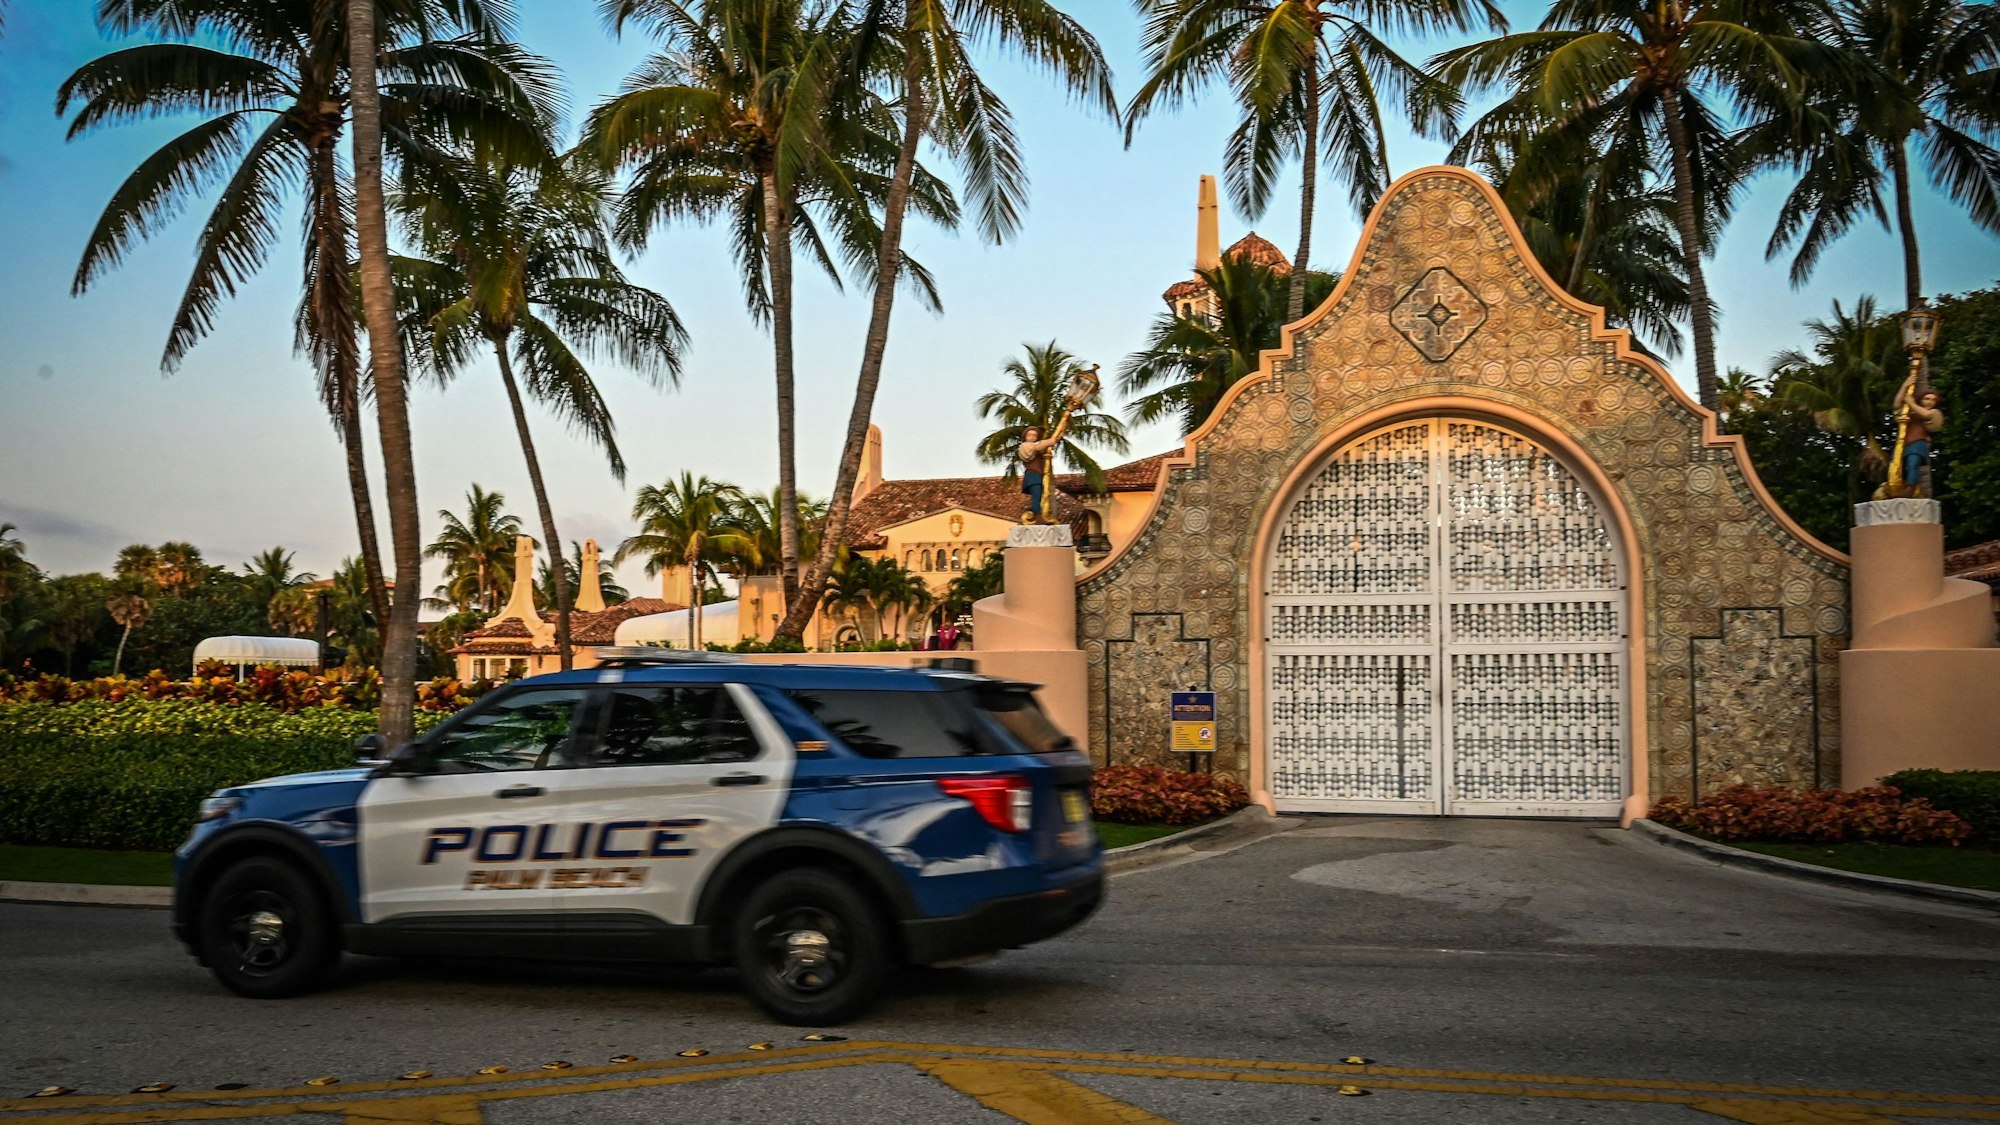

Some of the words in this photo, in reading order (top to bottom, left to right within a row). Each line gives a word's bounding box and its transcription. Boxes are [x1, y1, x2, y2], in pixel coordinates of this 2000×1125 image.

[420, 819, 706, 864] POLICE
[464, 870, 545, 890] PALM
[547, 867, 651, 889] BEACH
